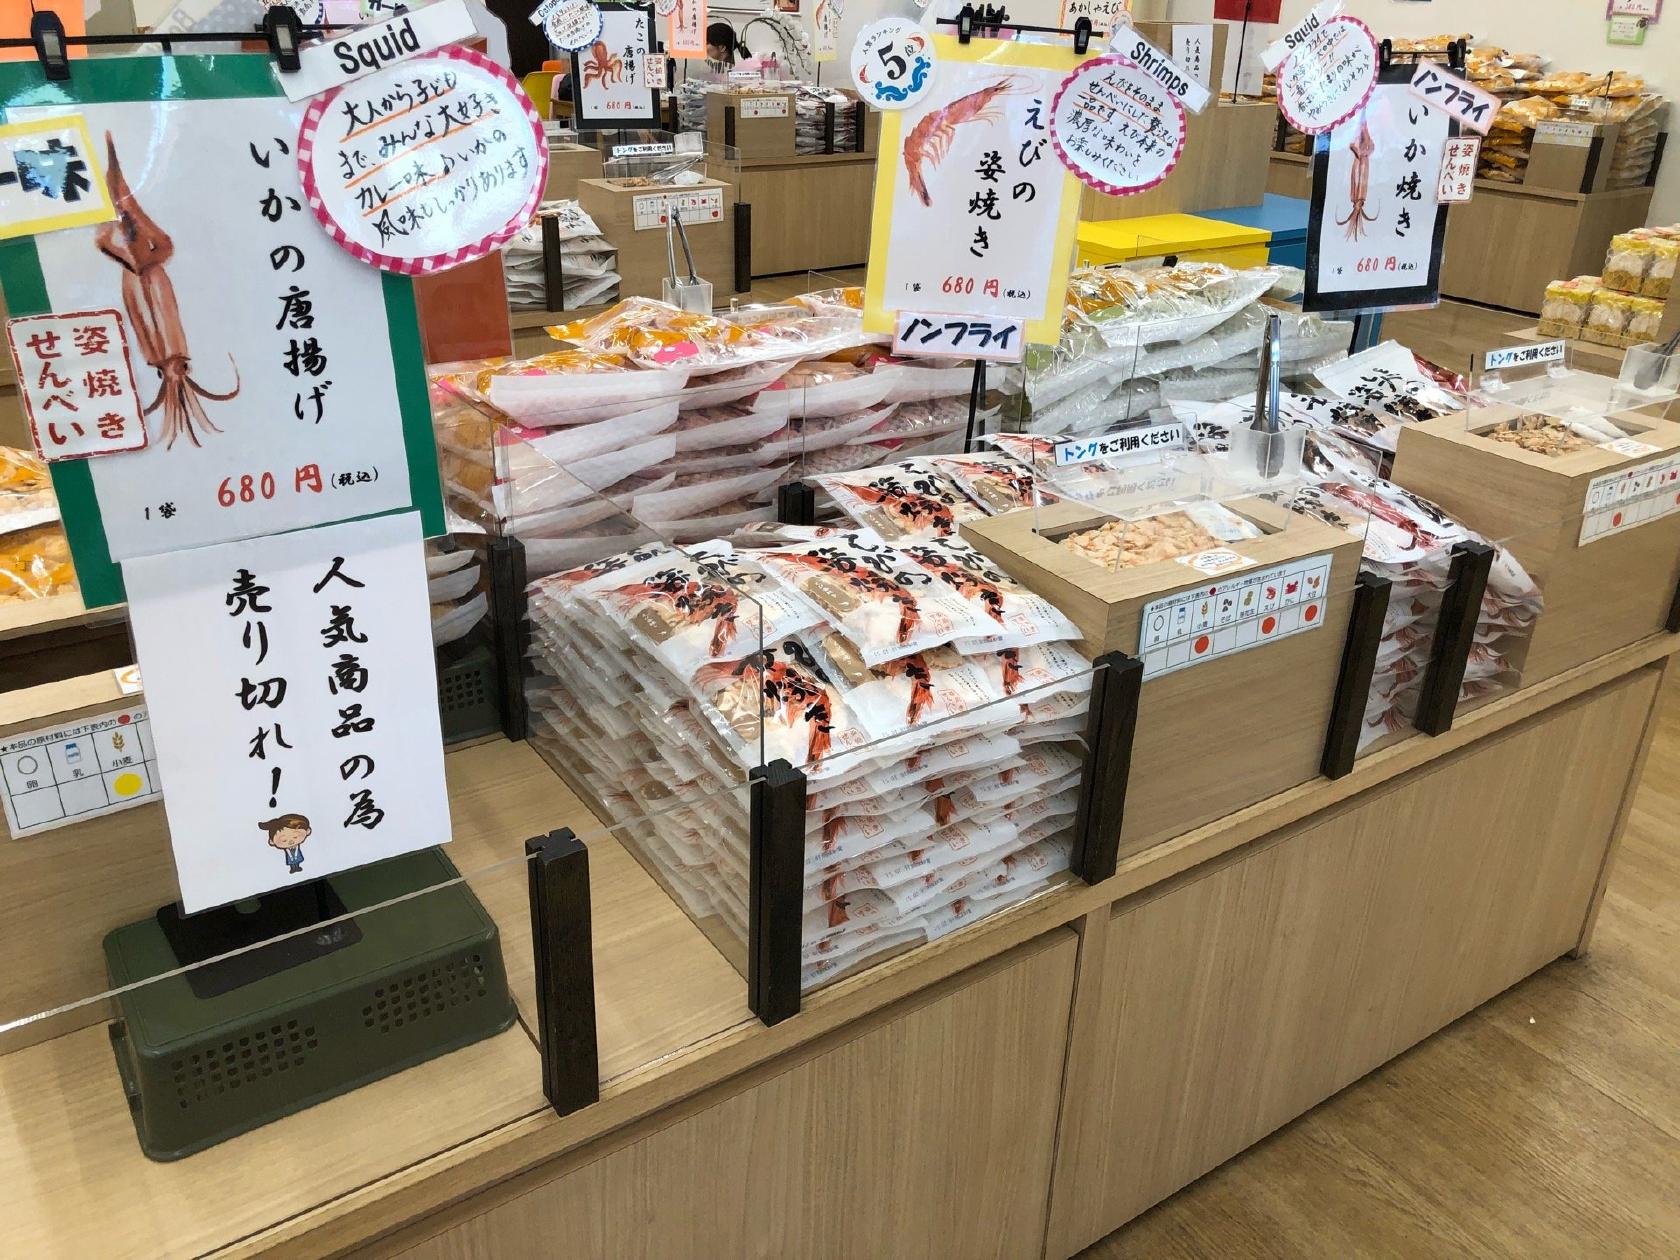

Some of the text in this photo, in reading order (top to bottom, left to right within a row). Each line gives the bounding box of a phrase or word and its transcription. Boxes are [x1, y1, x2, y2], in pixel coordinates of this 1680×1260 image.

[333, 18, 421, 75] Squid
[635, 17, 646, 55] たこの
[861, 25, 903, 57] 人気ランキング
[1284, 13, 1320, 50] Squid
[622, 45, 636, 85] 唐揚げ
[877, 41, 917, 80] 5 位
[1130, 41, 1189, 98] Shrimps
[341, 71, 458, 137] 大人から子ども
[1412, 68, 1491, 124] ノンフライ
[1012, 99, 1048, 203] えびの
[1395, 104, 1430, 239] いか焼き
[1442, 143, 1460, 195] せんべい
[1457, 143, 1474, 195] 姿焼き
[968, 151, 1006, 258] 姿焼き
[249, 136, 333, 425] いかの唐揚げ
[942, 276, 975, 296] 680
[1356, 256, 1380, 274] 680
[900, 317, 1018, 349] ノンフライ
[1490, 345, 1563, 367] トングをご利用ください
[26, 330, 85, 446] せんべい
[72, 323, 127, 440] 姿焼き
[1063, 428, 1181, 463] トングをご利用ください
[217, 473, 276, 509] 680
[225, 568, 294, 809] 売り切れ!
[312, 556, 386, 831] 人気商品の為
[112, 756, 134, 768] 小麦
